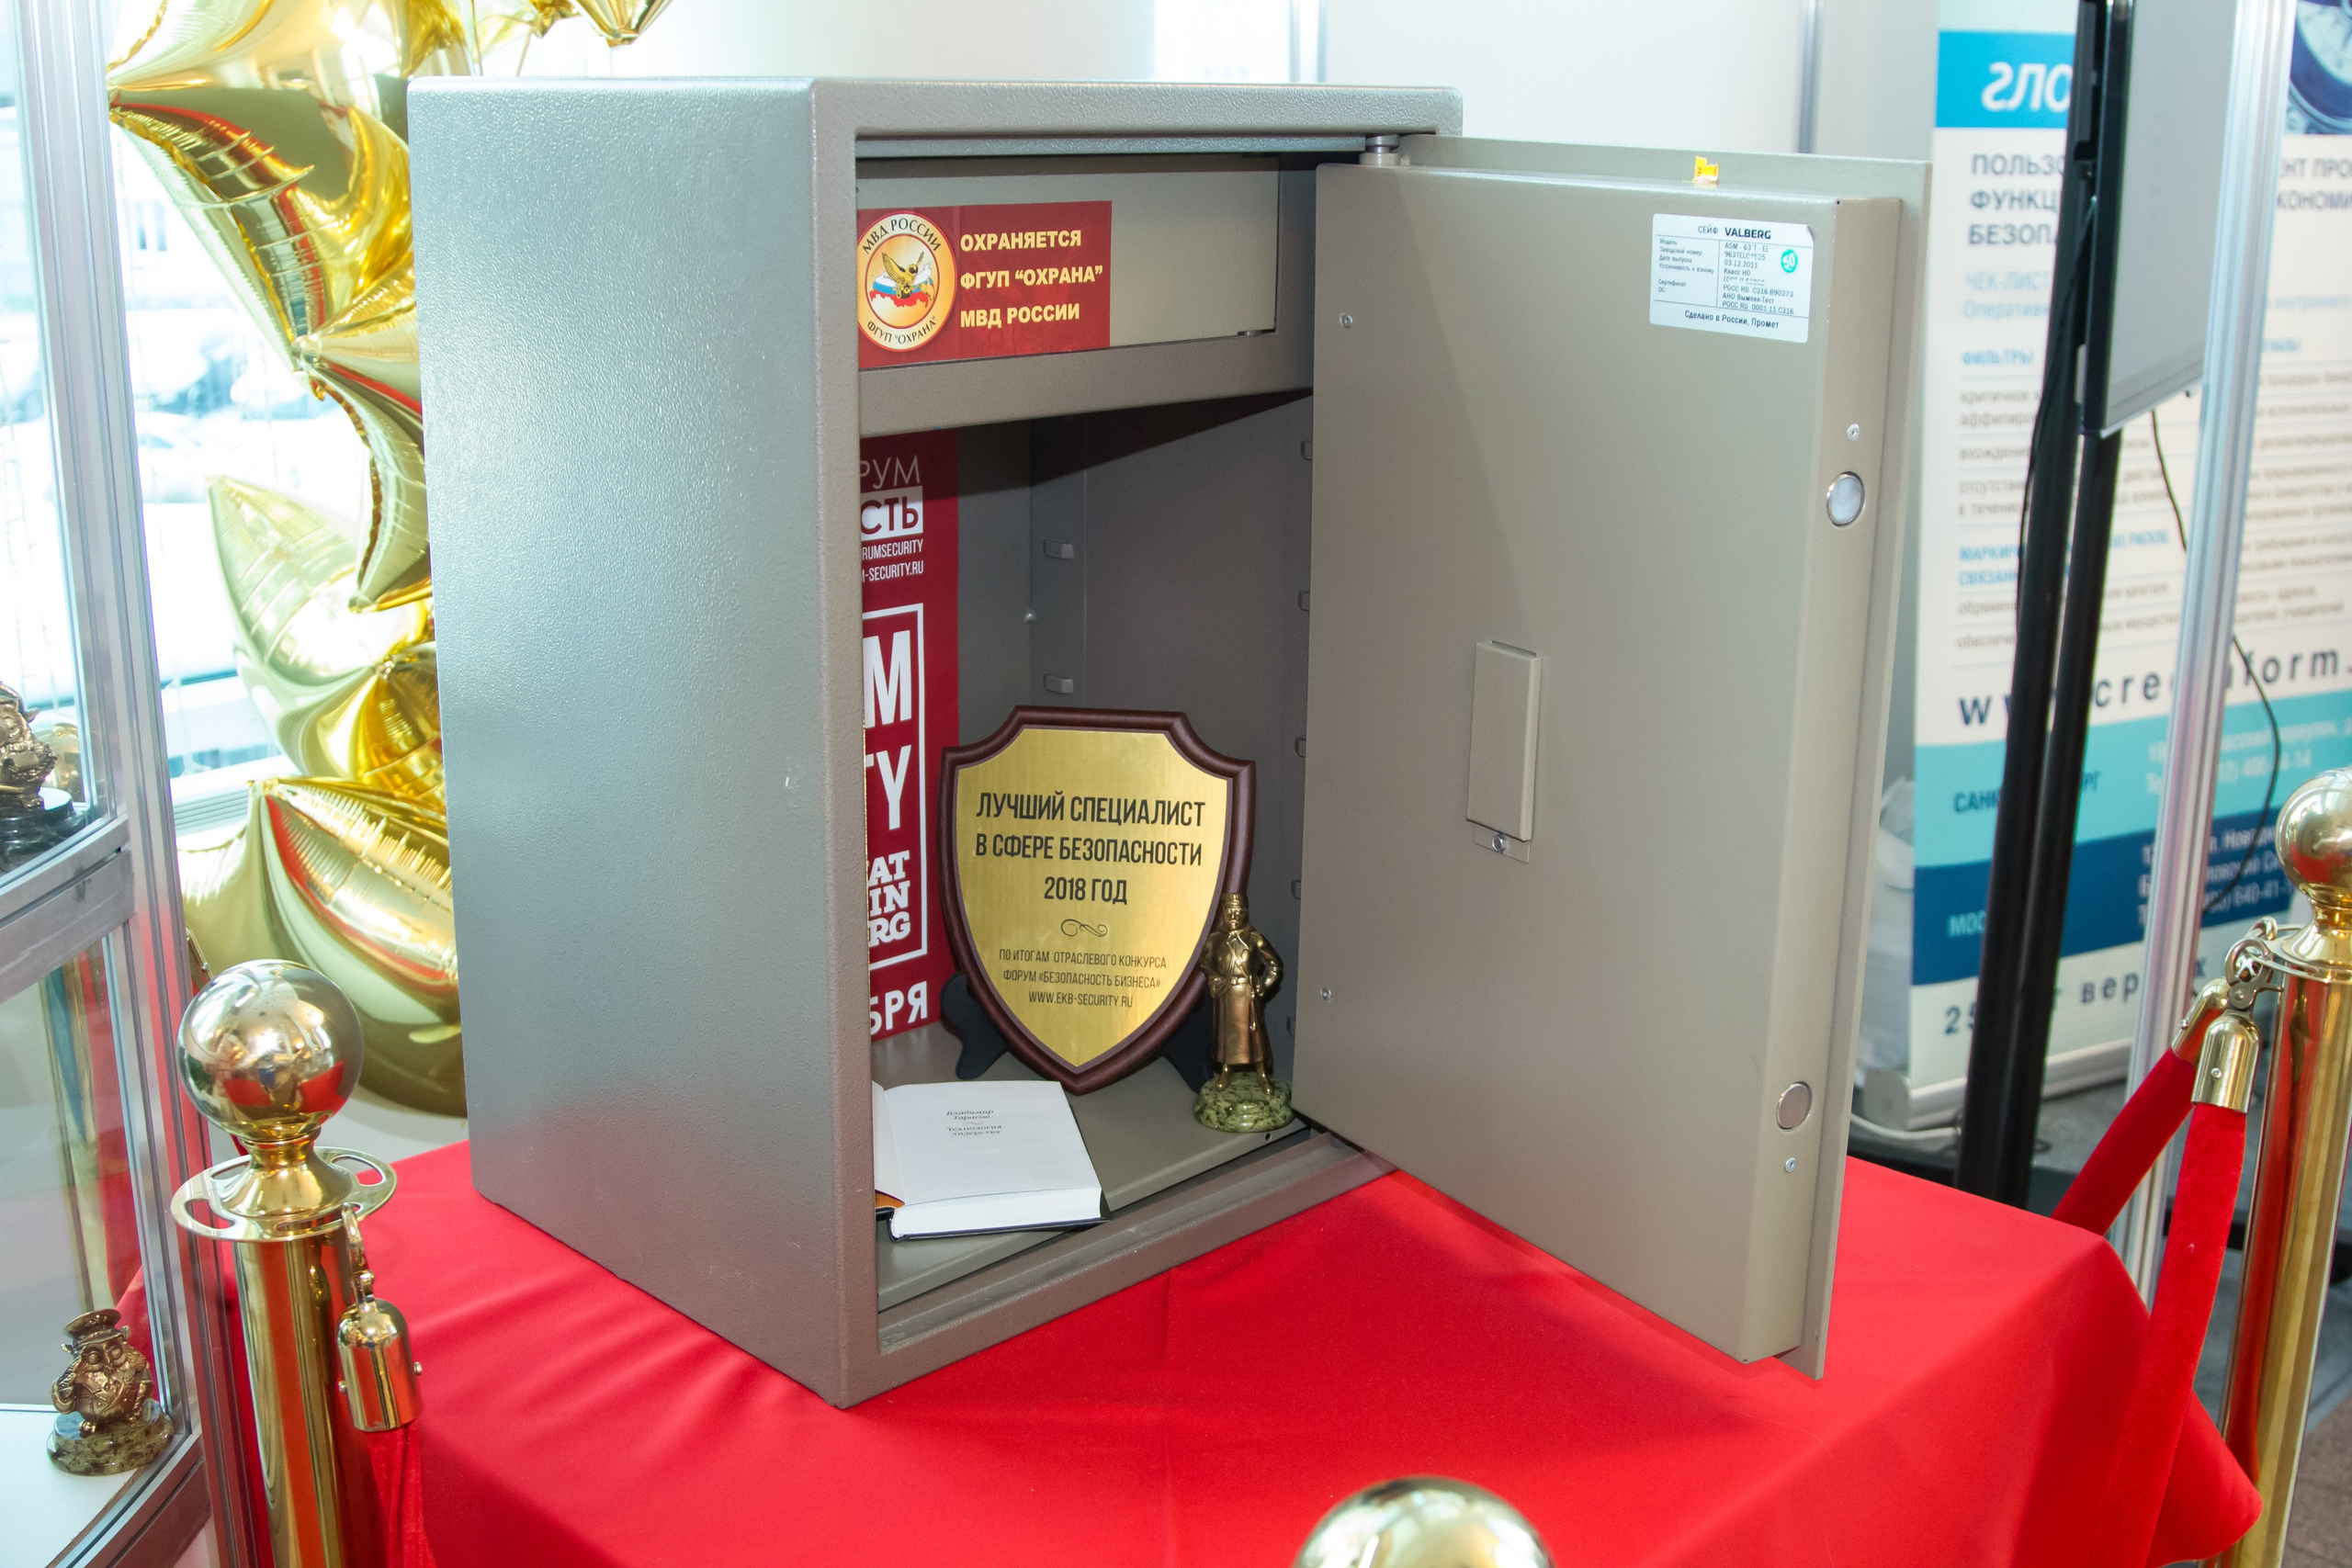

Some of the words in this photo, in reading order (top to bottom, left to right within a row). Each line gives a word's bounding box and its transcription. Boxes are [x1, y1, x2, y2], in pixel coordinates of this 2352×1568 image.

[863, 224, 888, 255] МВД
[890, 218, 941, 252] РОССИИ
[960, 230, 1081, 252] ОХРАНЯЕТСЯ
[1697, 224, 1718, 234] СЕЙФ
[1724, 227, 1771, 240] VALBERG
[1969, 223, 2057, 245] БЕЗОП
[960, 270, 1010, 290] ФГУП
[960, 308, 1001, 329] МВД
[1007, 303, 1080, 324] РОССИИ
[1685, 310, 1713, 321] Сделано
[1751, 318, 1780, 328] Промет
[867, 321, 893, 343] ФГУП
[860, 455, 920, 490] РУМ
[861, 496, 919, 536] СТЬ
[862, 538, 924, 561] RUMSECURITY
[863, 629, 912, 729] M
[865, 744, 912, 830] Y
[976, 790, 1065, 821] ЛУЧШИЙ
[1070, 795, 1205, 827] СПЕЦИАЛИСТ
[975, 833, 987, 857] В
[992, 834, 1054, 859] СФЕРЕ
[1059, 836, 1202, 866] БЕЗОПАСНОСТИ
[868, 850, 910, 887] AT
[869, 880, 910, 917] IN
[1044, 876, 1086, 901] 2018
[1091, 878, 1128, 905] ГОД
[868, 911, 911, 948] RG
[999, 948, 1011, 961] ПО
[1012, 949, 1049, 963] ИТОГАМ
[1054, 951, 1117, 965] ОТРАСЛЕВОГО
[1119, 954, 1167, 968] КОНКУРСА
[1003, 969, 1036, 982] ФОРУМ
[2081, 973, 2139, 1005] вер
[870, 980, 928, 1035] БРЯ
[1028, 990, 1133, 1009] WWW.EKB-SECURITY.RU
